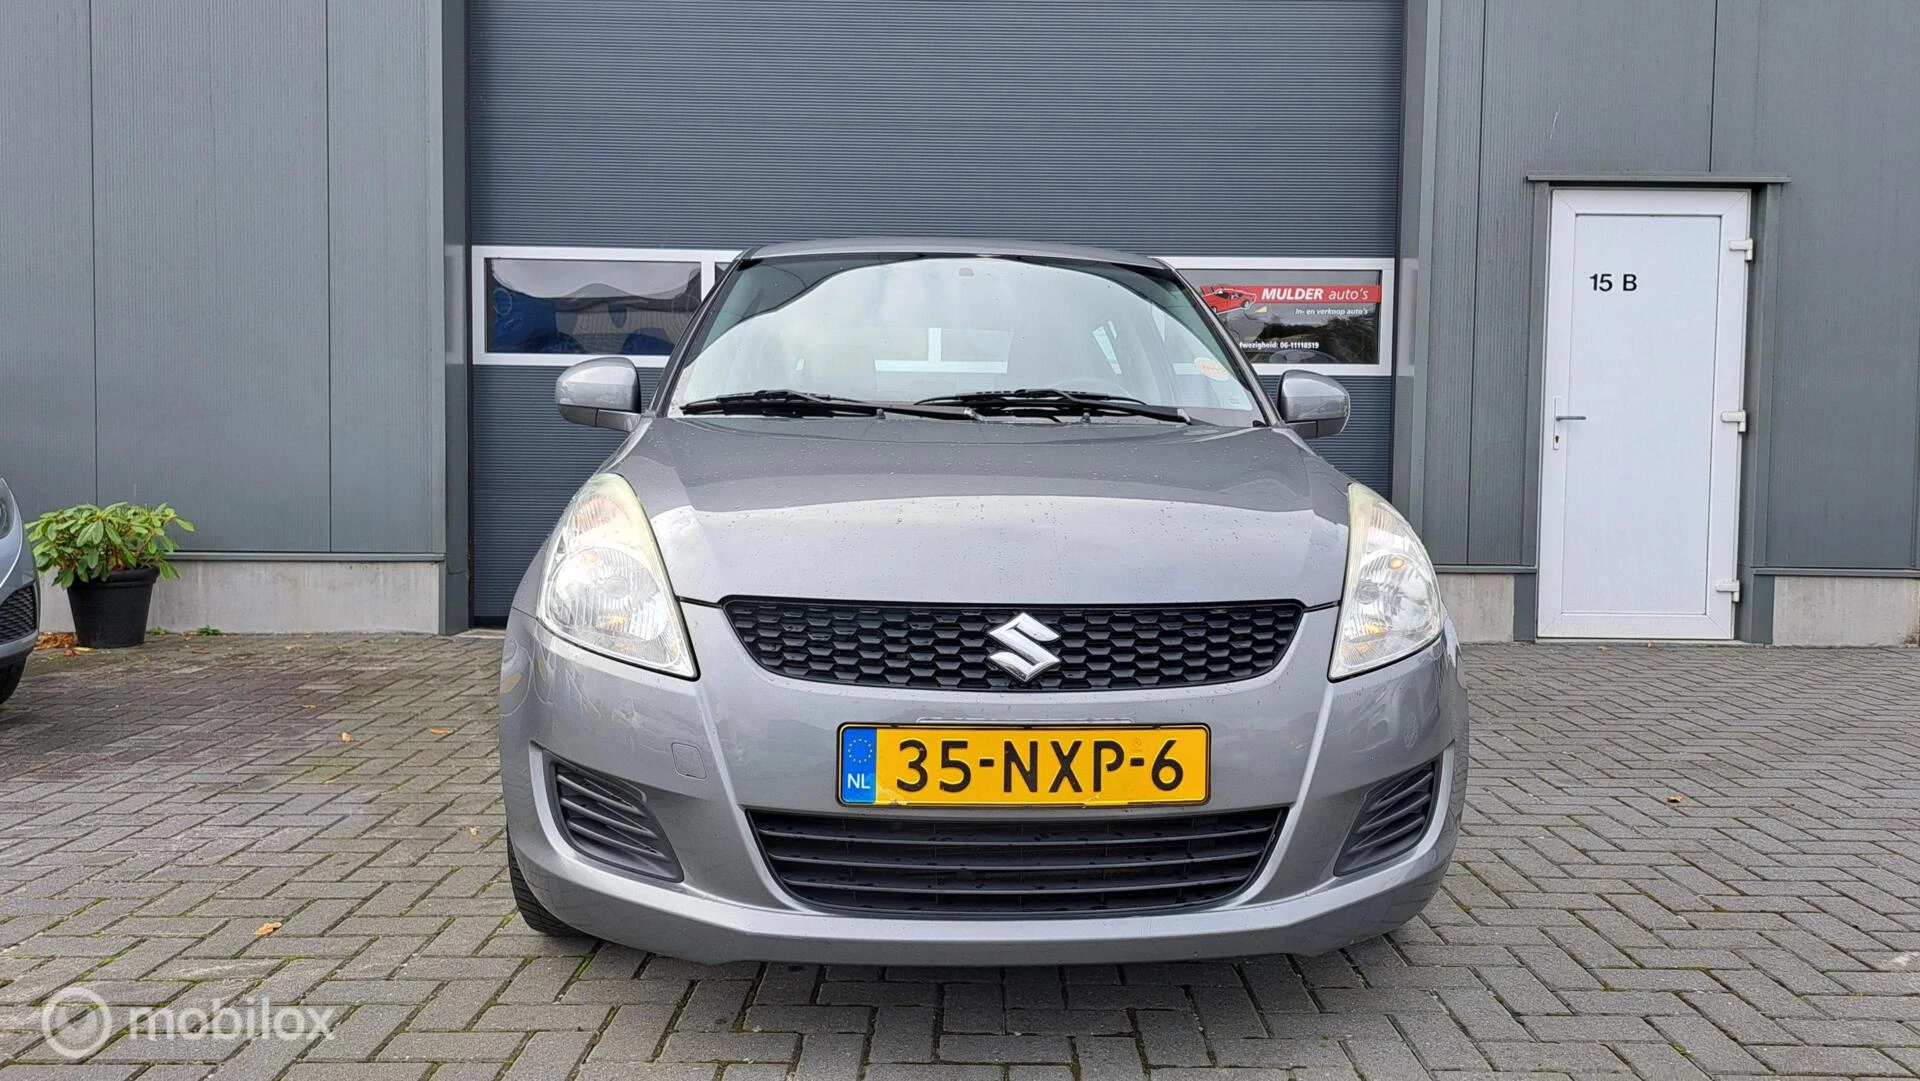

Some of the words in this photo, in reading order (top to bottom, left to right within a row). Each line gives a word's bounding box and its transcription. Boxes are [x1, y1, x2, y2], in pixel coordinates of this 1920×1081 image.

[1589, 273, 1613, 292] 15
[1622, 273, 1637, 291] B
[1261, 287, 1323, 300] MULDER
[1328, 288, 1369, 300] auto's
[1316, 308, 1346, 317] verkoop
[1347, 308, 1369, 316] auto's
[1239, 341, 1278, 350] fwezigheid:
[896, 739, 1183, 793] 35-NXP-6
[847, 773, 870, 789] NL
